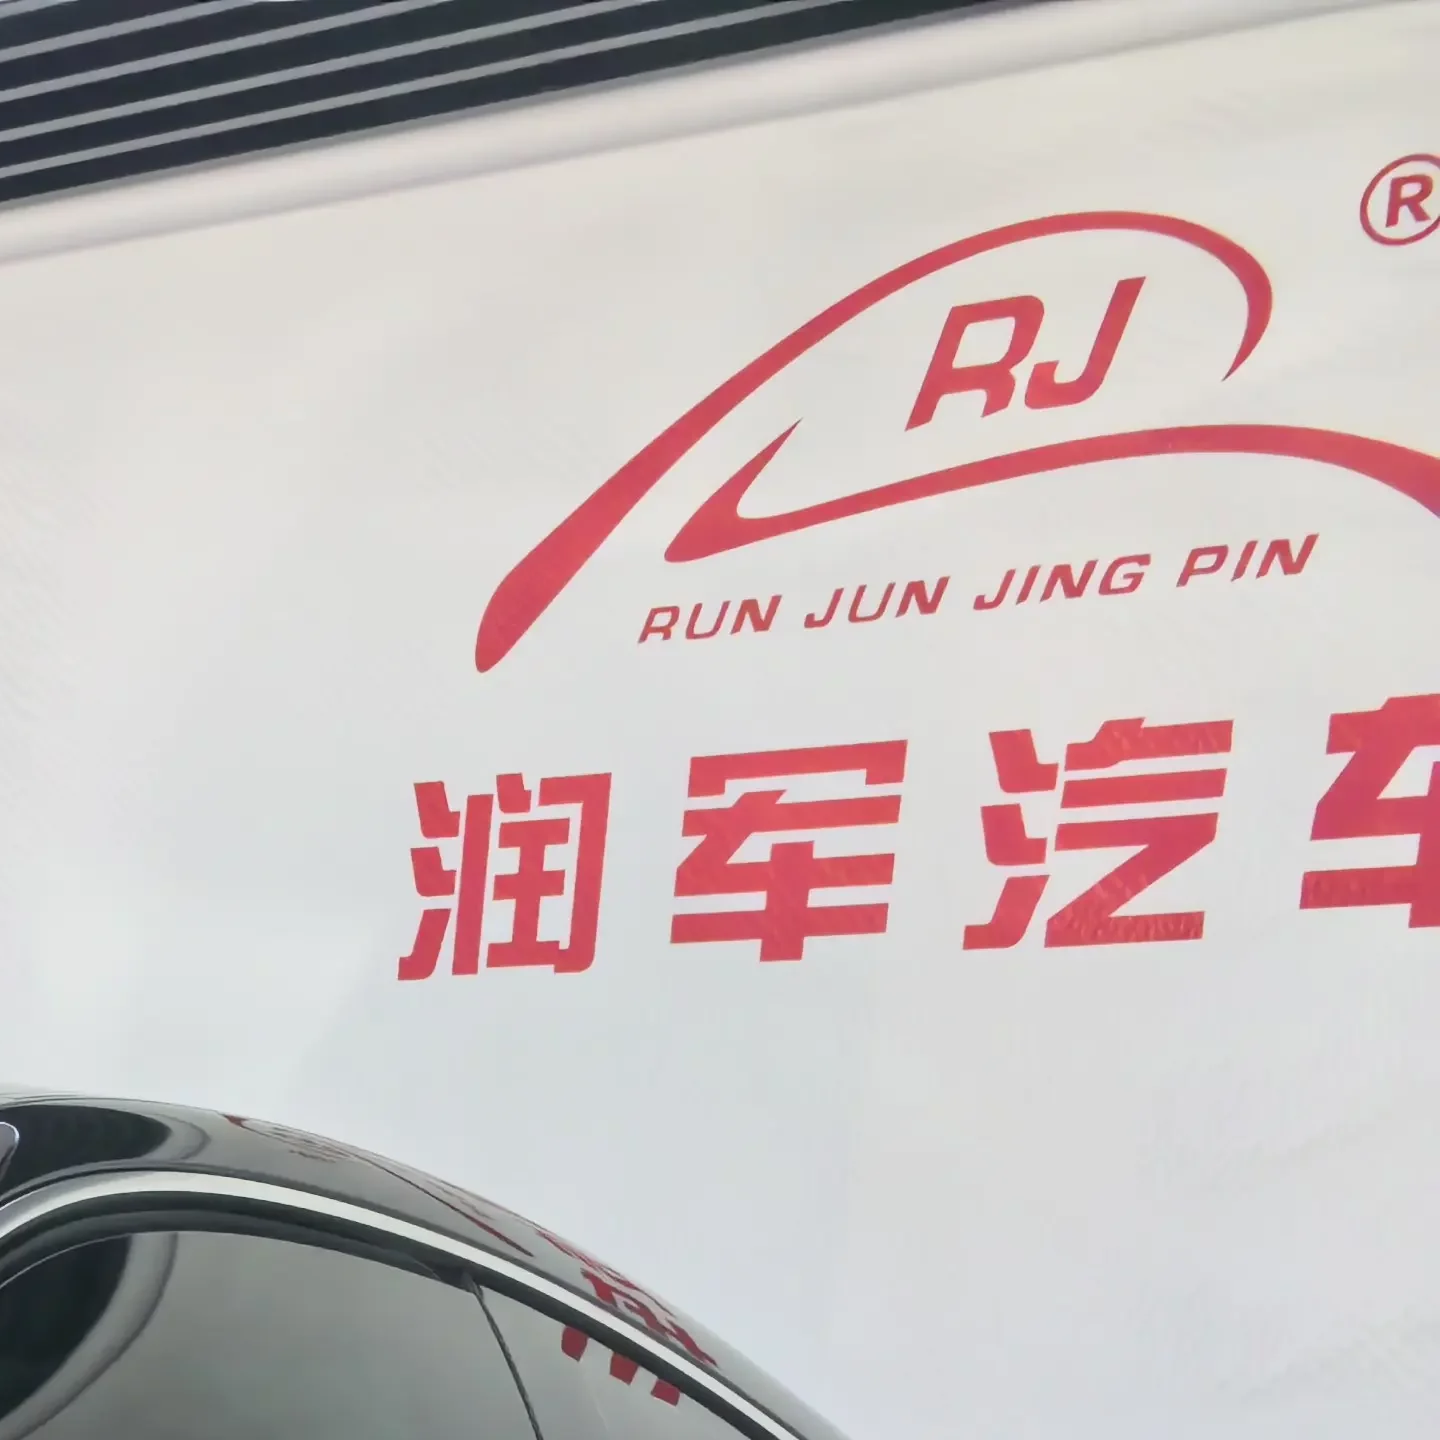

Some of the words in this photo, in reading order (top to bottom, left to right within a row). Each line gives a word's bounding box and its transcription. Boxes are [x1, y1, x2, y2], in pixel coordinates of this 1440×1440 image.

[906, 278, 1146, 430] RJ
[638, 595, 782, 644] RUN
[804, 577, 950, 629] JUN
[973, 553, 1151, 611] JING
[1176, 534, 1319, 587] PIN
